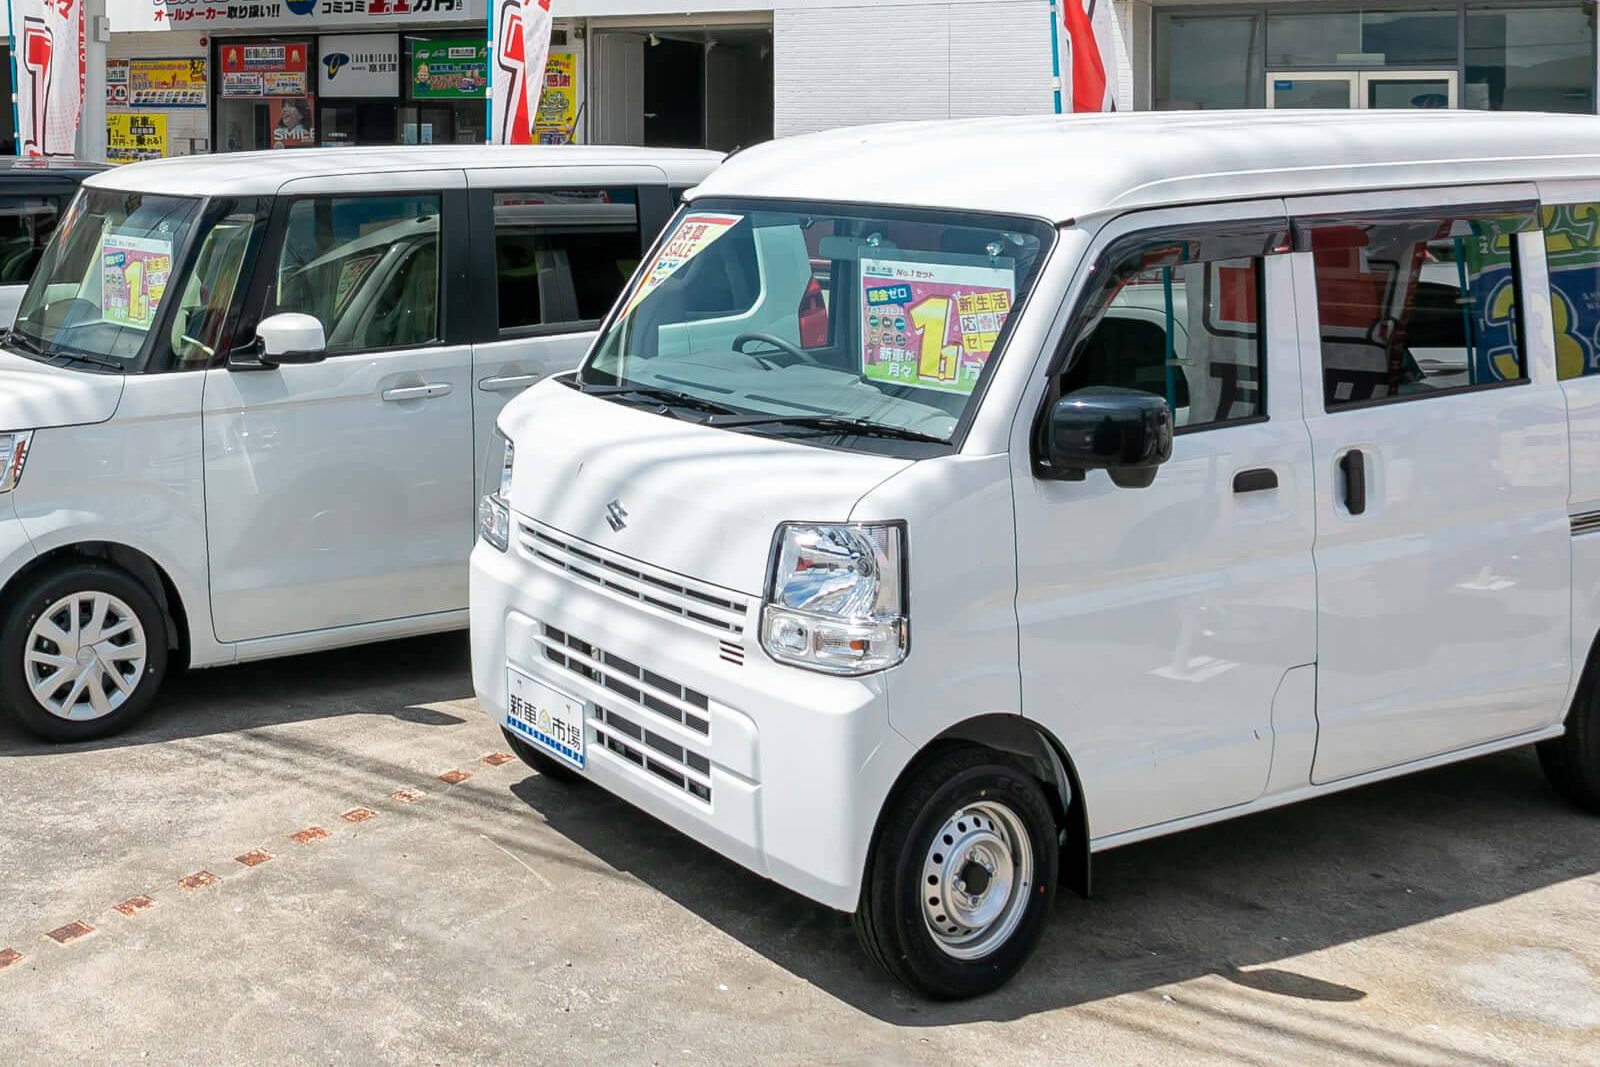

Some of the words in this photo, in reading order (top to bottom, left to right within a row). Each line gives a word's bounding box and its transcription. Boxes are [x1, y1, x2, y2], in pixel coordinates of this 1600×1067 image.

[321, 0, 366, 14] コミコミ
[273, 127, 316, 141] SMILE
[676, 223, 710, 242] 決算
[664, 242, 697, 258] SALE
[959, 293, 1008, 313] 新生活
[909, 296, 959, 381] 1.1
[887, 363, 913, 379] 月々
[510, 694, 581, 751] 新車市場
